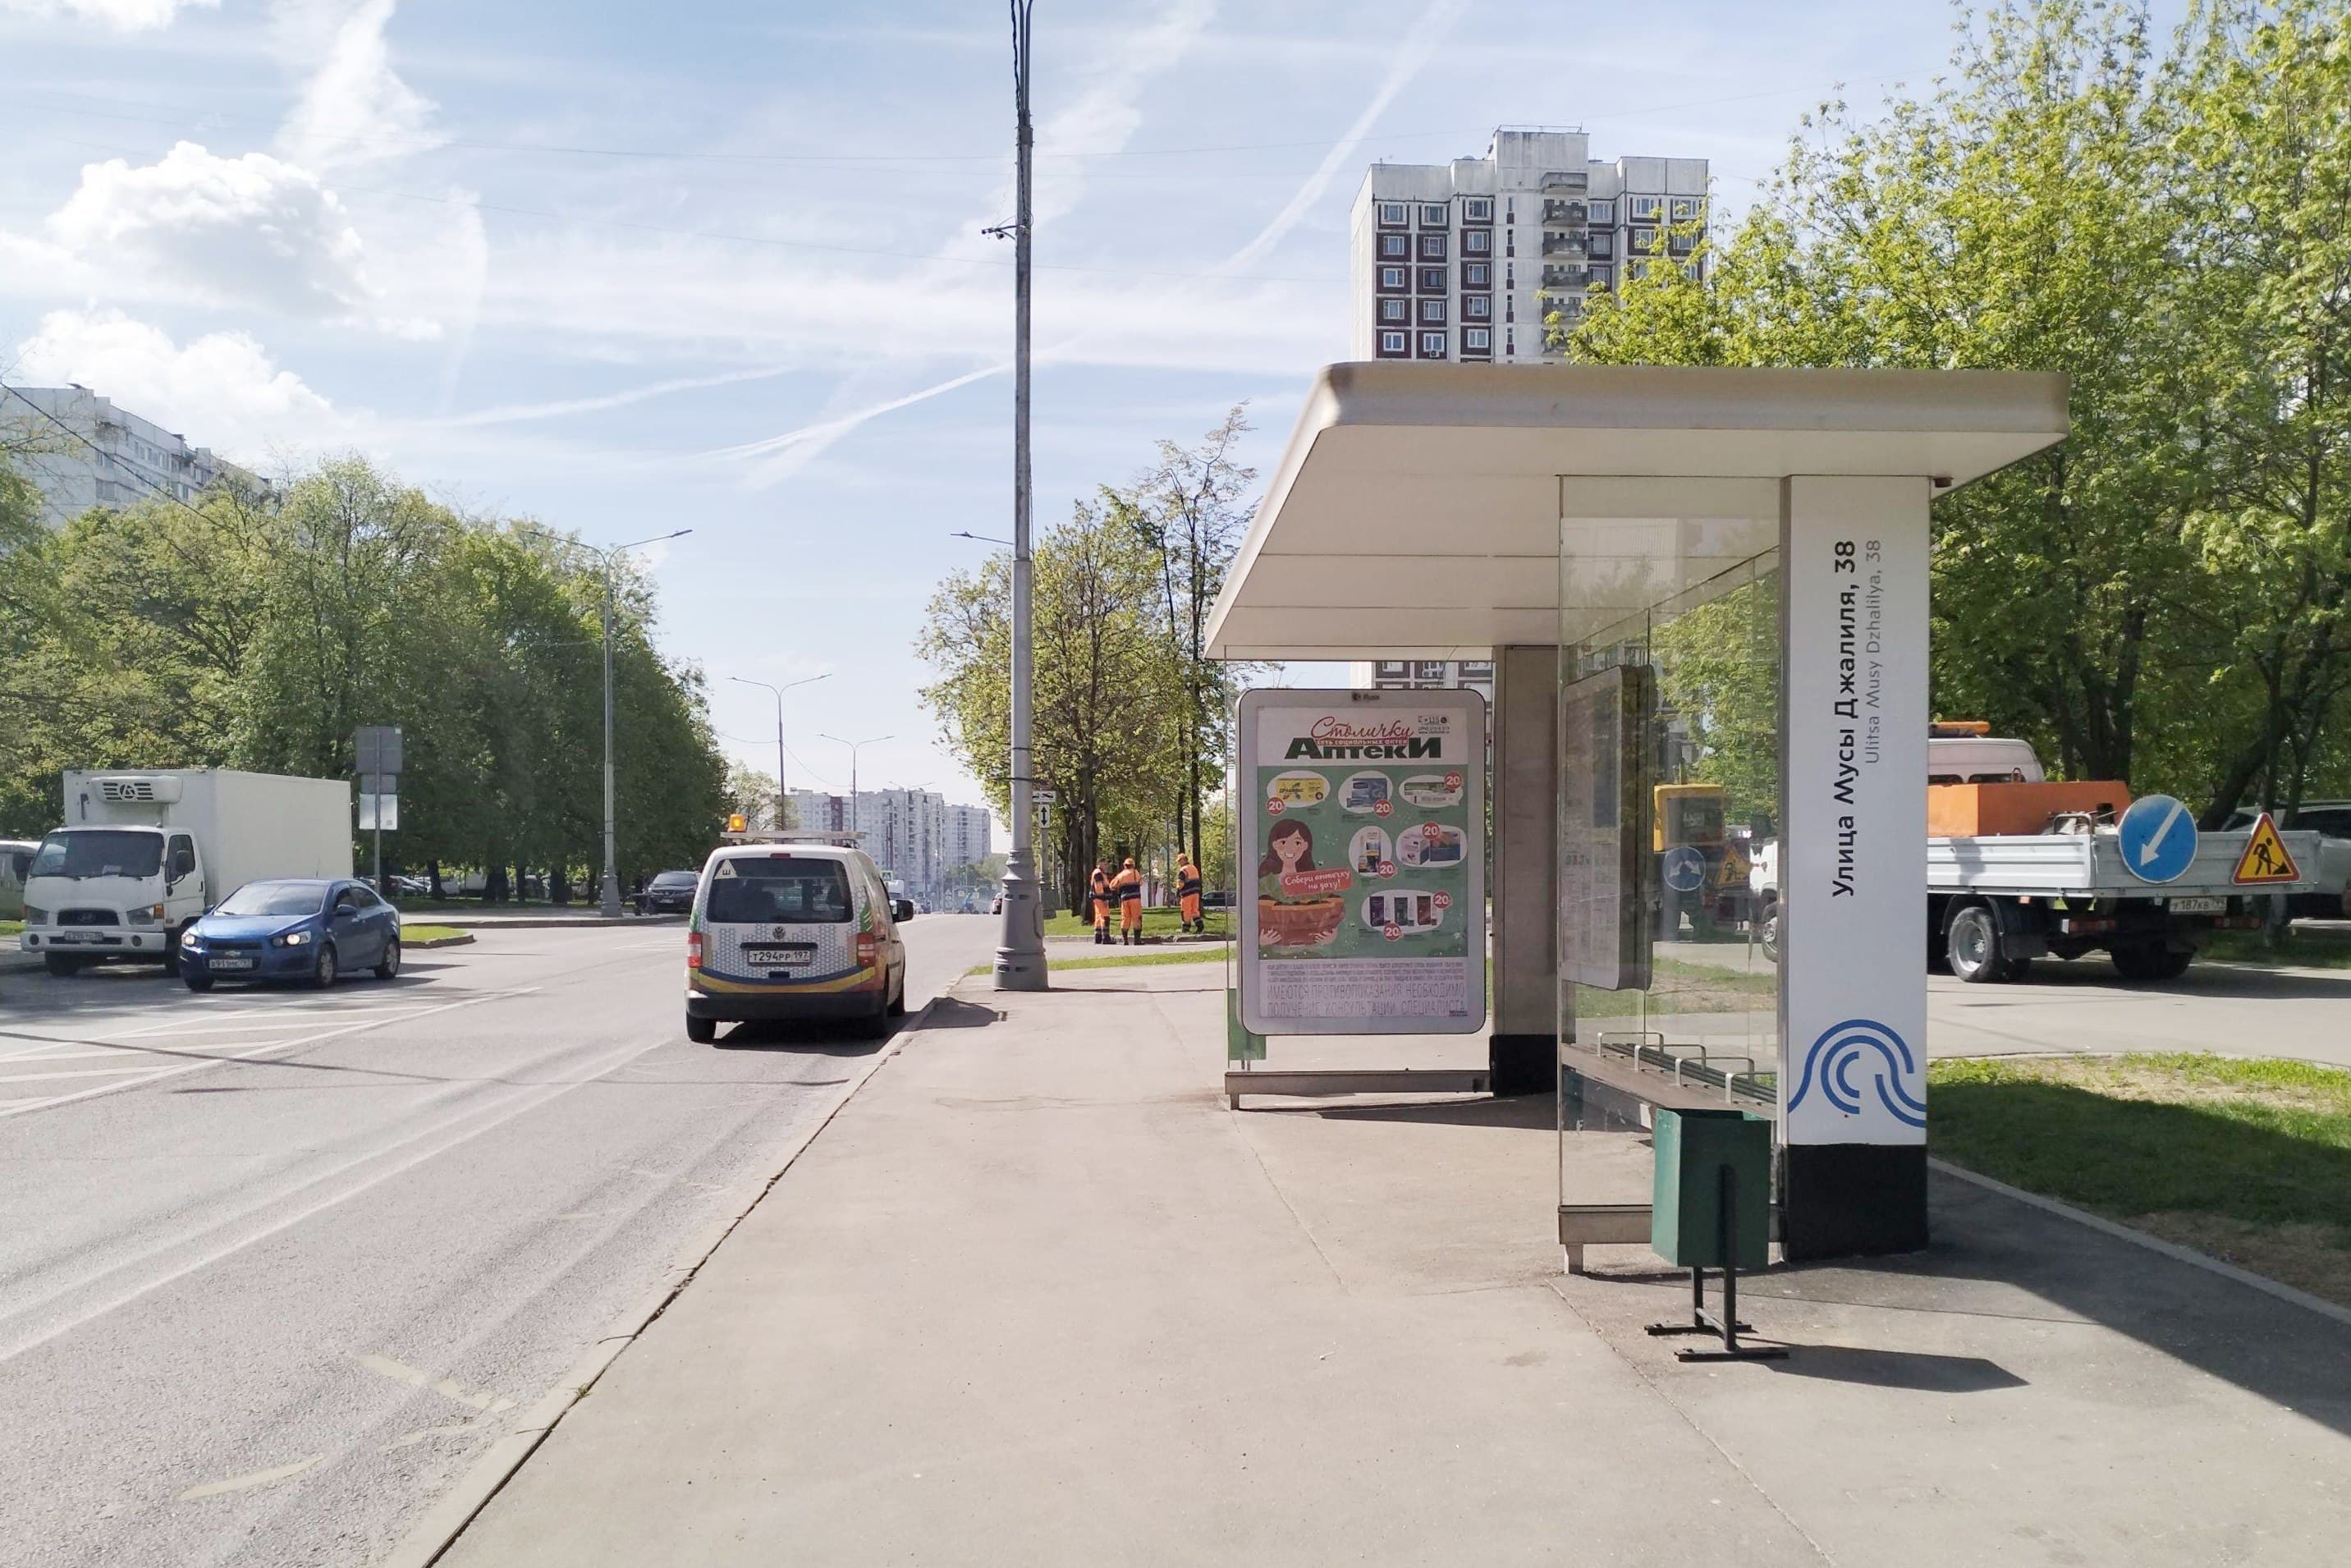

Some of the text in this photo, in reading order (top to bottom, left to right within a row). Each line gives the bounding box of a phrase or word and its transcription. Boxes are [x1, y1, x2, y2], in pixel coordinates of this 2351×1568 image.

[1865, 540, 1884, 764] Ulitsa Musy Dzhalilya, 38
[1311, 716, 1414, 738] Столички
[1832, 540, 1860, 897] Улица Мусы Джалиля, 38
[1285, 875, 1313, 886] Собери
